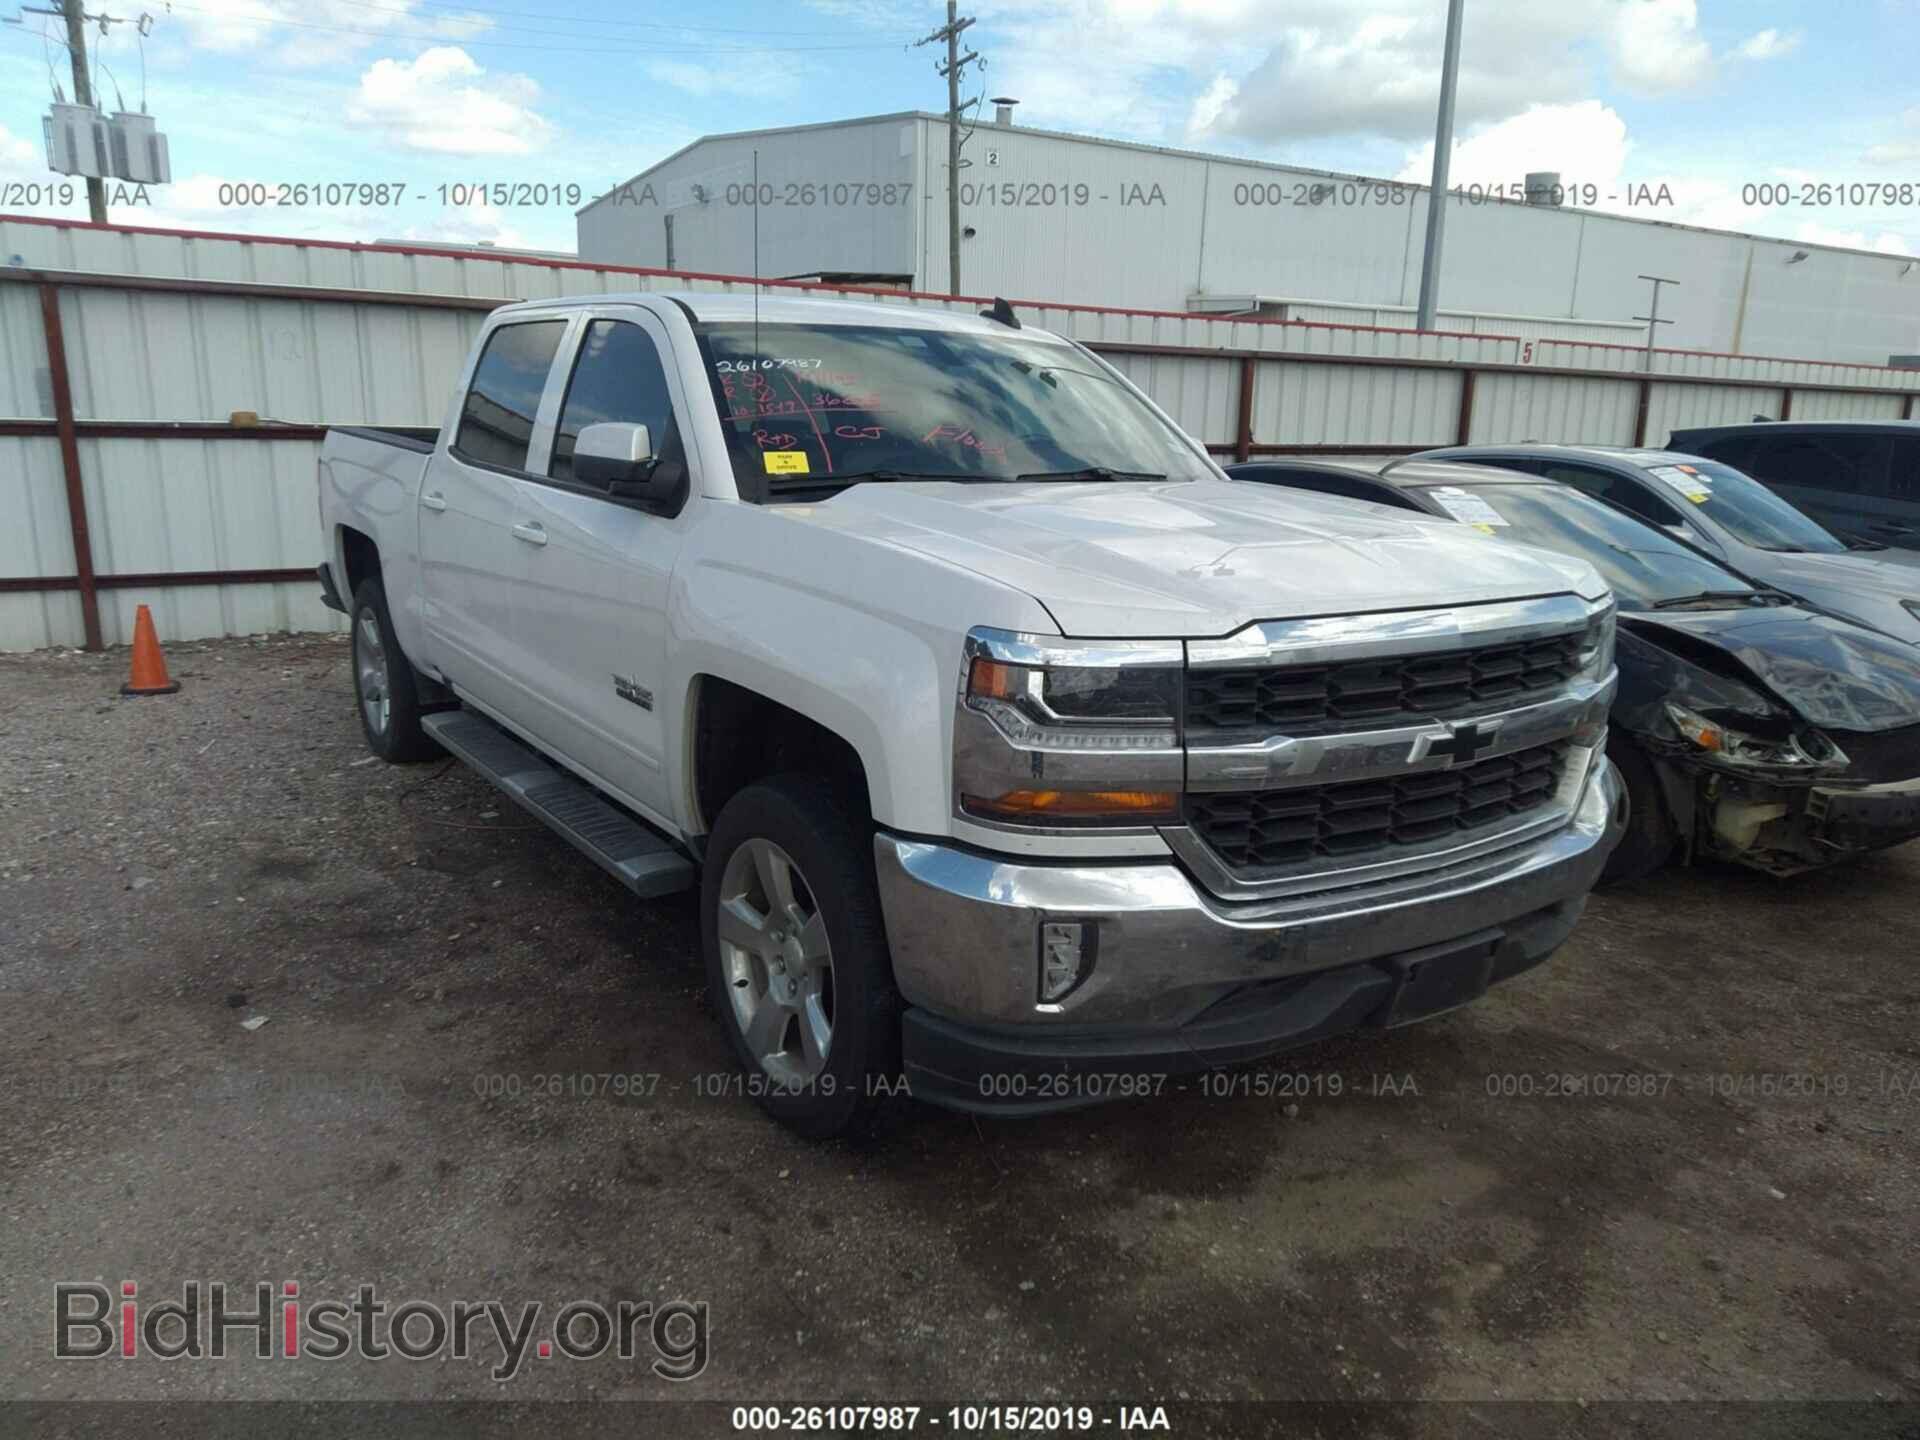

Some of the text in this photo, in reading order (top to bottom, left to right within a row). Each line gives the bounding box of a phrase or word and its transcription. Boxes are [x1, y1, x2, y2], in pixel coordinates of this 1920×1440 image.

[989, 152, 997, 165] 2
[1522, 342, 1533, 363] 5
[716, 358, 823, 373] 26107987
